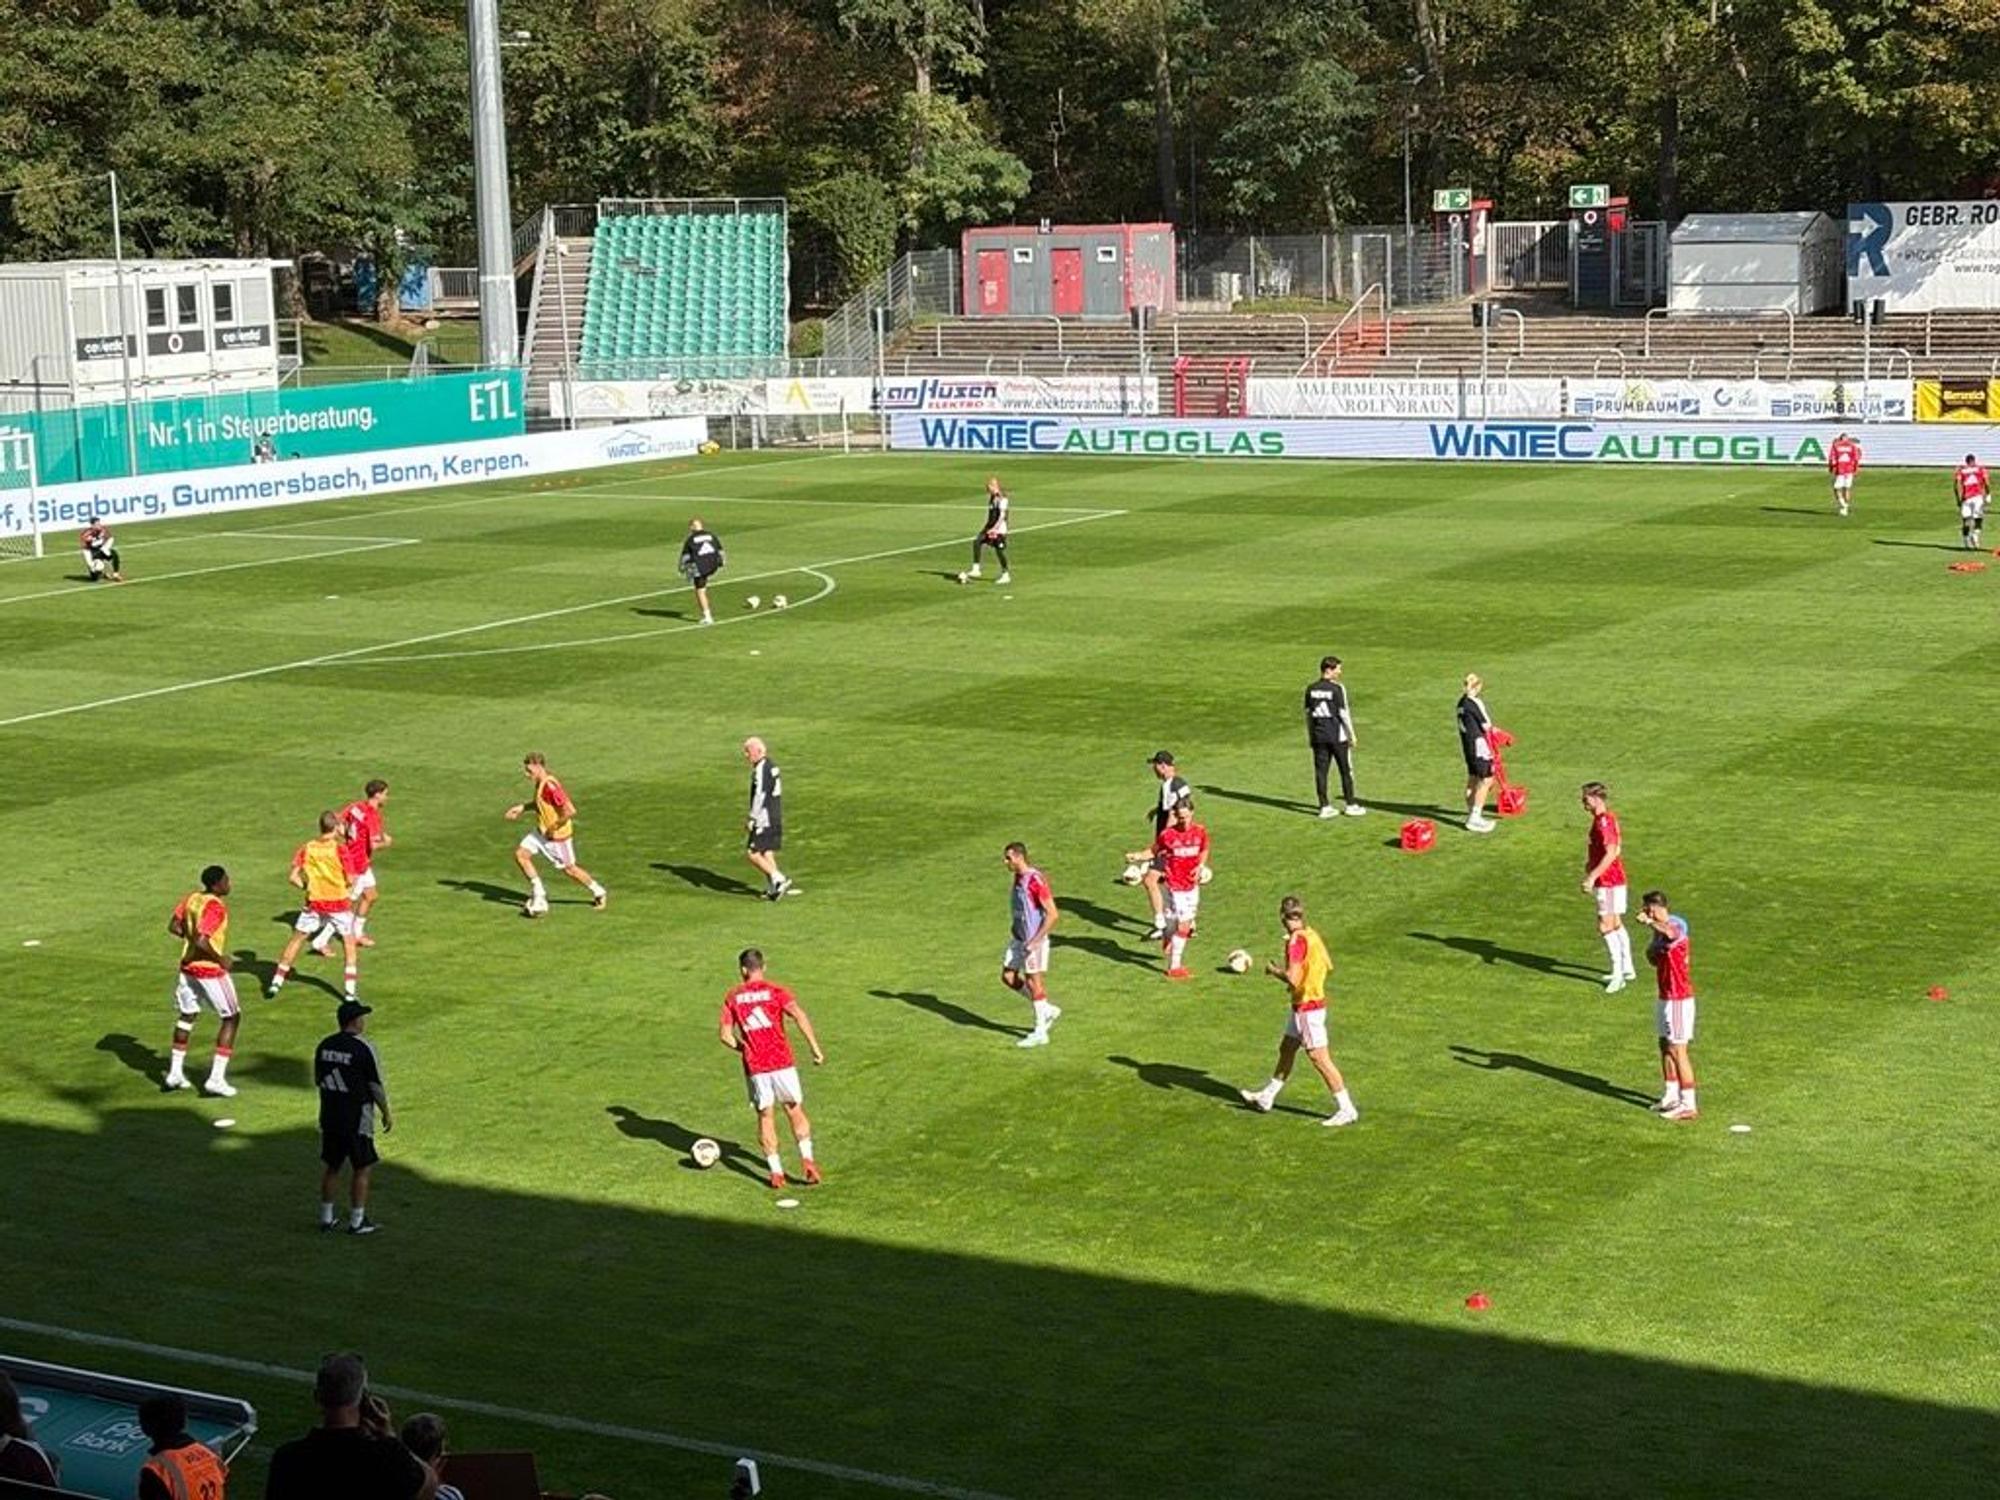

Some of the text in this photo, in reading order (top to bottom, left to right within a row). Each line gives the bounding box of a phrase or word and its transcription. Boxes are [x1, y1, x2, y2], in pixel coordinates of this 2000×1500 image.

[1905, 205, 1964, 226] GEBR.
[469, 379, 517, 422] ETL
[149, 405, 378, 448] Nr. 1 in Steuerberatung.
[1063, 428, 1285, 454] AUTOGLAS
[1597, 434, 1862, 463] AUTOGLA
[29, 493, 166, 527] Siegburg,
[172, 465, 367, 508] Gummersbach,
[372, 460, 439, 485] Bonn,
[443, 451, 529, 478] Kerpen.
